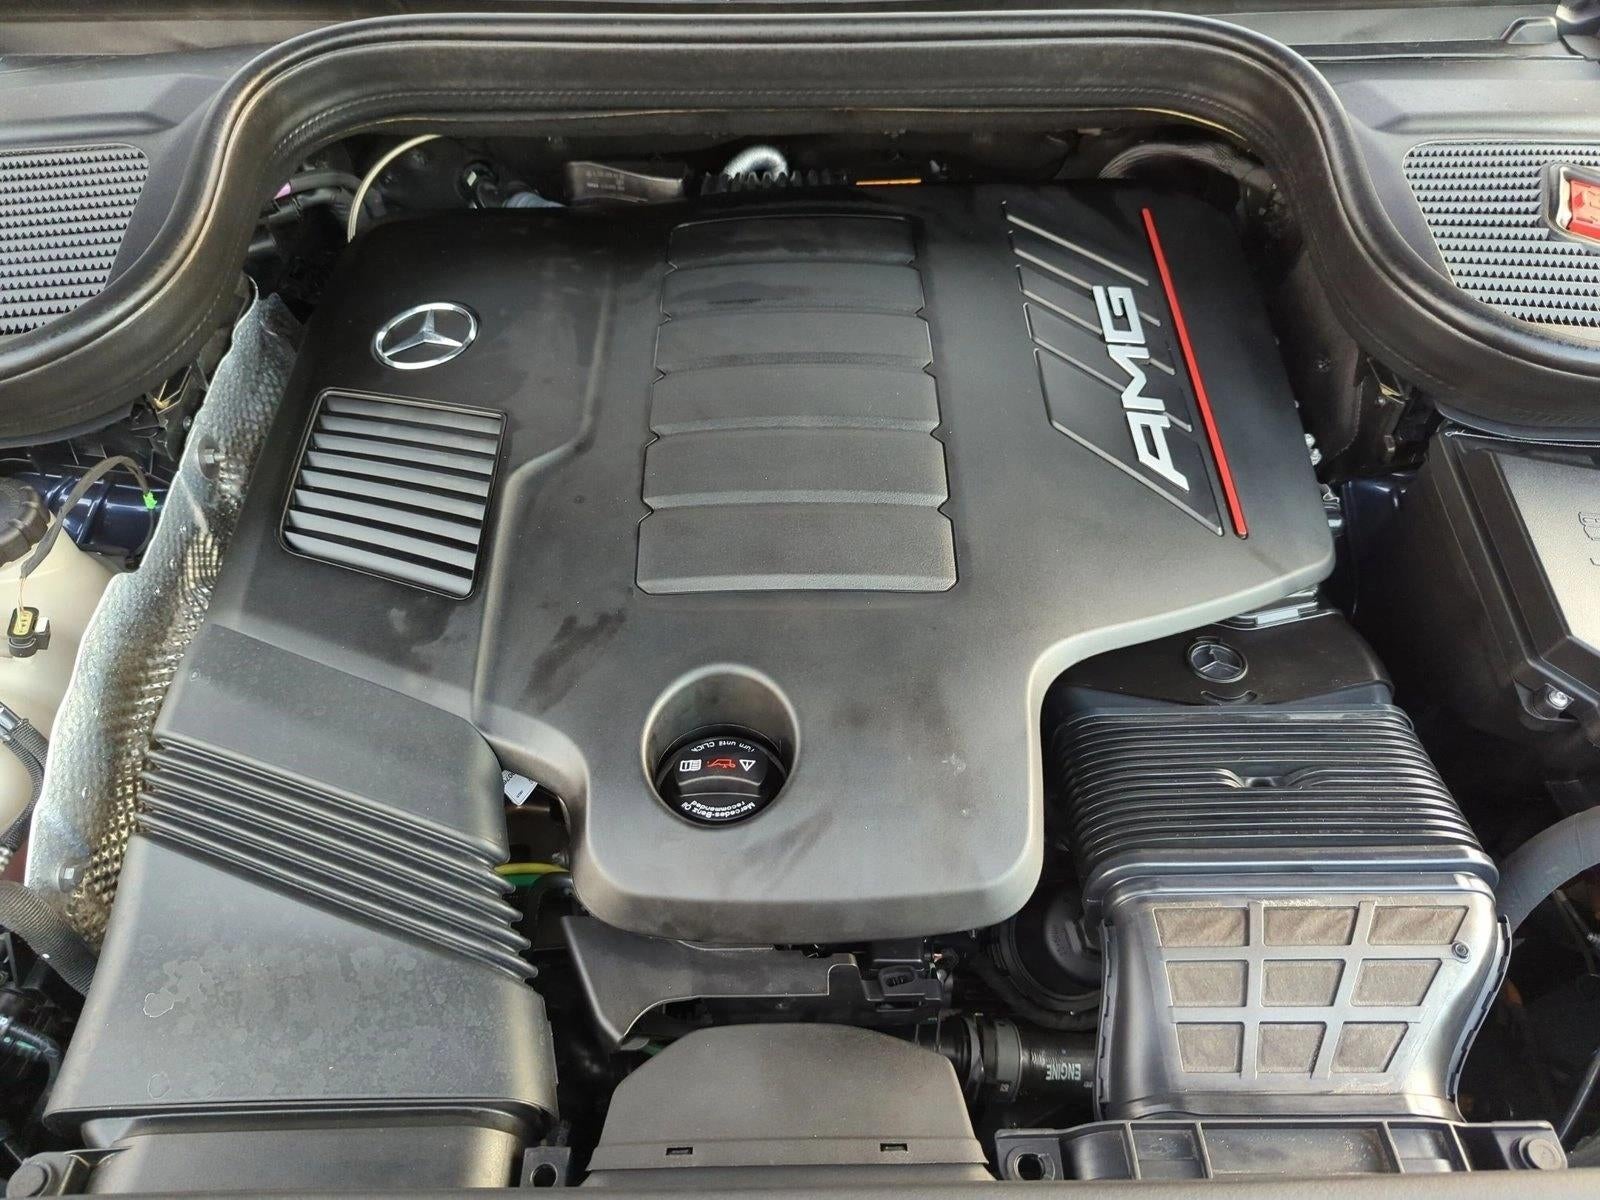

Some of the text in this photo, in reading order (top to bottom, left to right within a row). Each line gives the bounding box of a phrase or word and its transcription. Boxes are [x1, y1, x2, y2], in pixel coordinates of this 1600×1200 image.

[1092, 285, 1190, 492] AMG
[691, 741, 715, 753] CLICK
[680, 801, 756, 819] Mercedes-Benz Oil
[690, 800, 745, 812] recommended
[1045, 1063, 1082, 1081] ENGINE
